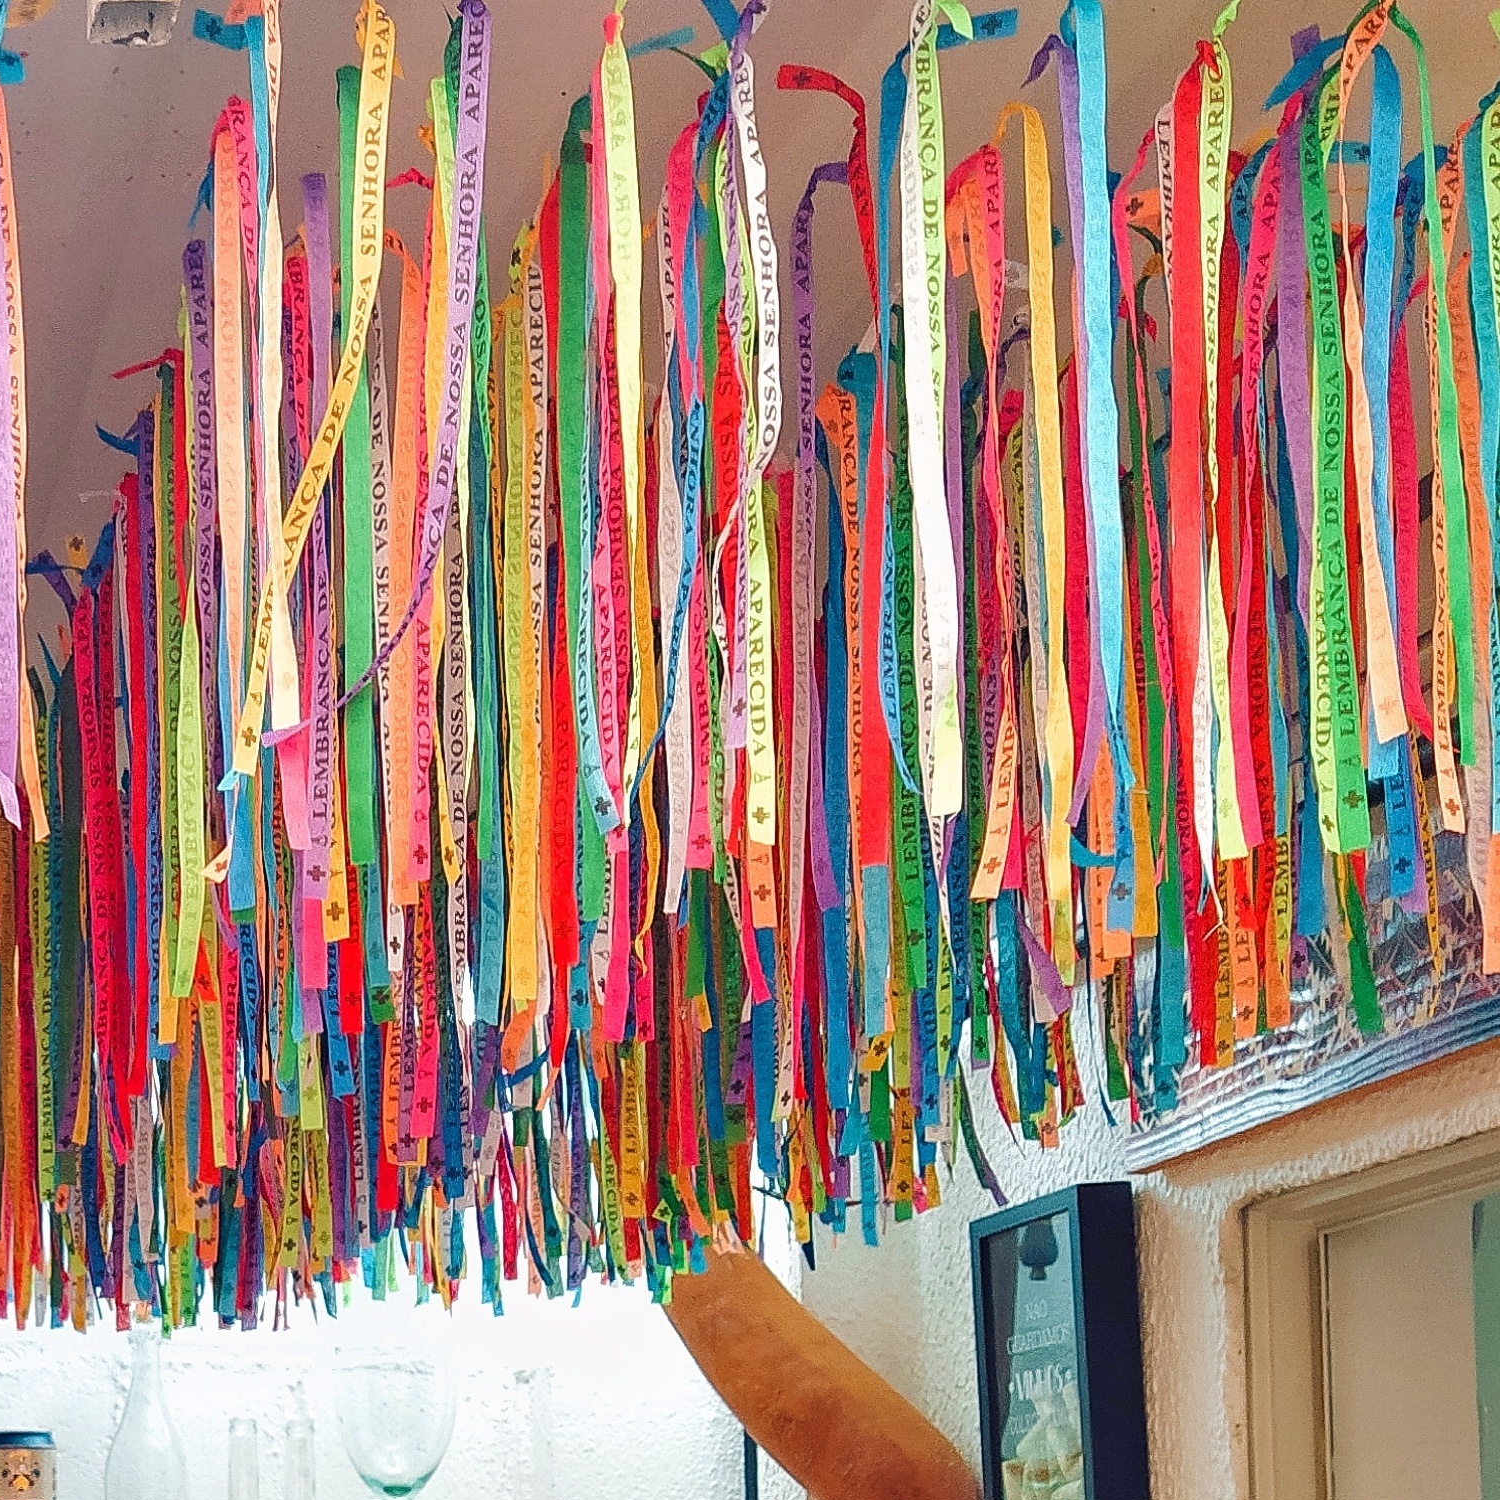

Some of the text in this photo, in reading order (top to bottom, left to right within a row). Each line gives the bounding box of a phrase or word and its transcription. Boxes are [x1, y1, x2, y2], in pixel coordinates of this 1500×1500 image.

[322, 102, 383, 448] DE NOSSA SENHORA
[455, 145, 479, 305] SENHORA
[751, 191, 778, 352] SENHORA
[922, 198, 942, 356] DE NOSSA
[1206, 212, 1220, 362] SENHORA
[447, 322, 466, 430] NOSSA
[799, 312, 813, 449] SENHORA
[1248, 252, 1271, 391] SENHORA
[198, 367, 213, 510] SENHORA
[371, 414, 388, 554] DE NOSSA
[435, 439, 452, 490] DE
[757, 361, 780, 469] NOSSA
[1312, 209, 1358, 738] LEMBRANÇA DE NOSSA SENHORA
[199, 524, 213, 618] NOSSA
[529, 432, 544, 568] SENHORA
[609, 464, 624, 599] SENHORA
[848, 500, 858, 532] DE
[578, 568, 593, 750] APARECIDA
[849, 546, 860, 635] NOSSA
[1434, 511, 1450, 752] LEMBRANÇA DE
[312, 585, 331, 822] LEMBRANÇA DE
[414, 618, 432, 796] APARECIDA
[449, 552, 466, 825] DE NOSSA SENHORA
[596, 583, 615, 768] APARECIDA
[748, 578, 768, 757] APARECIDA
[901, 646, 914, 688] DE
